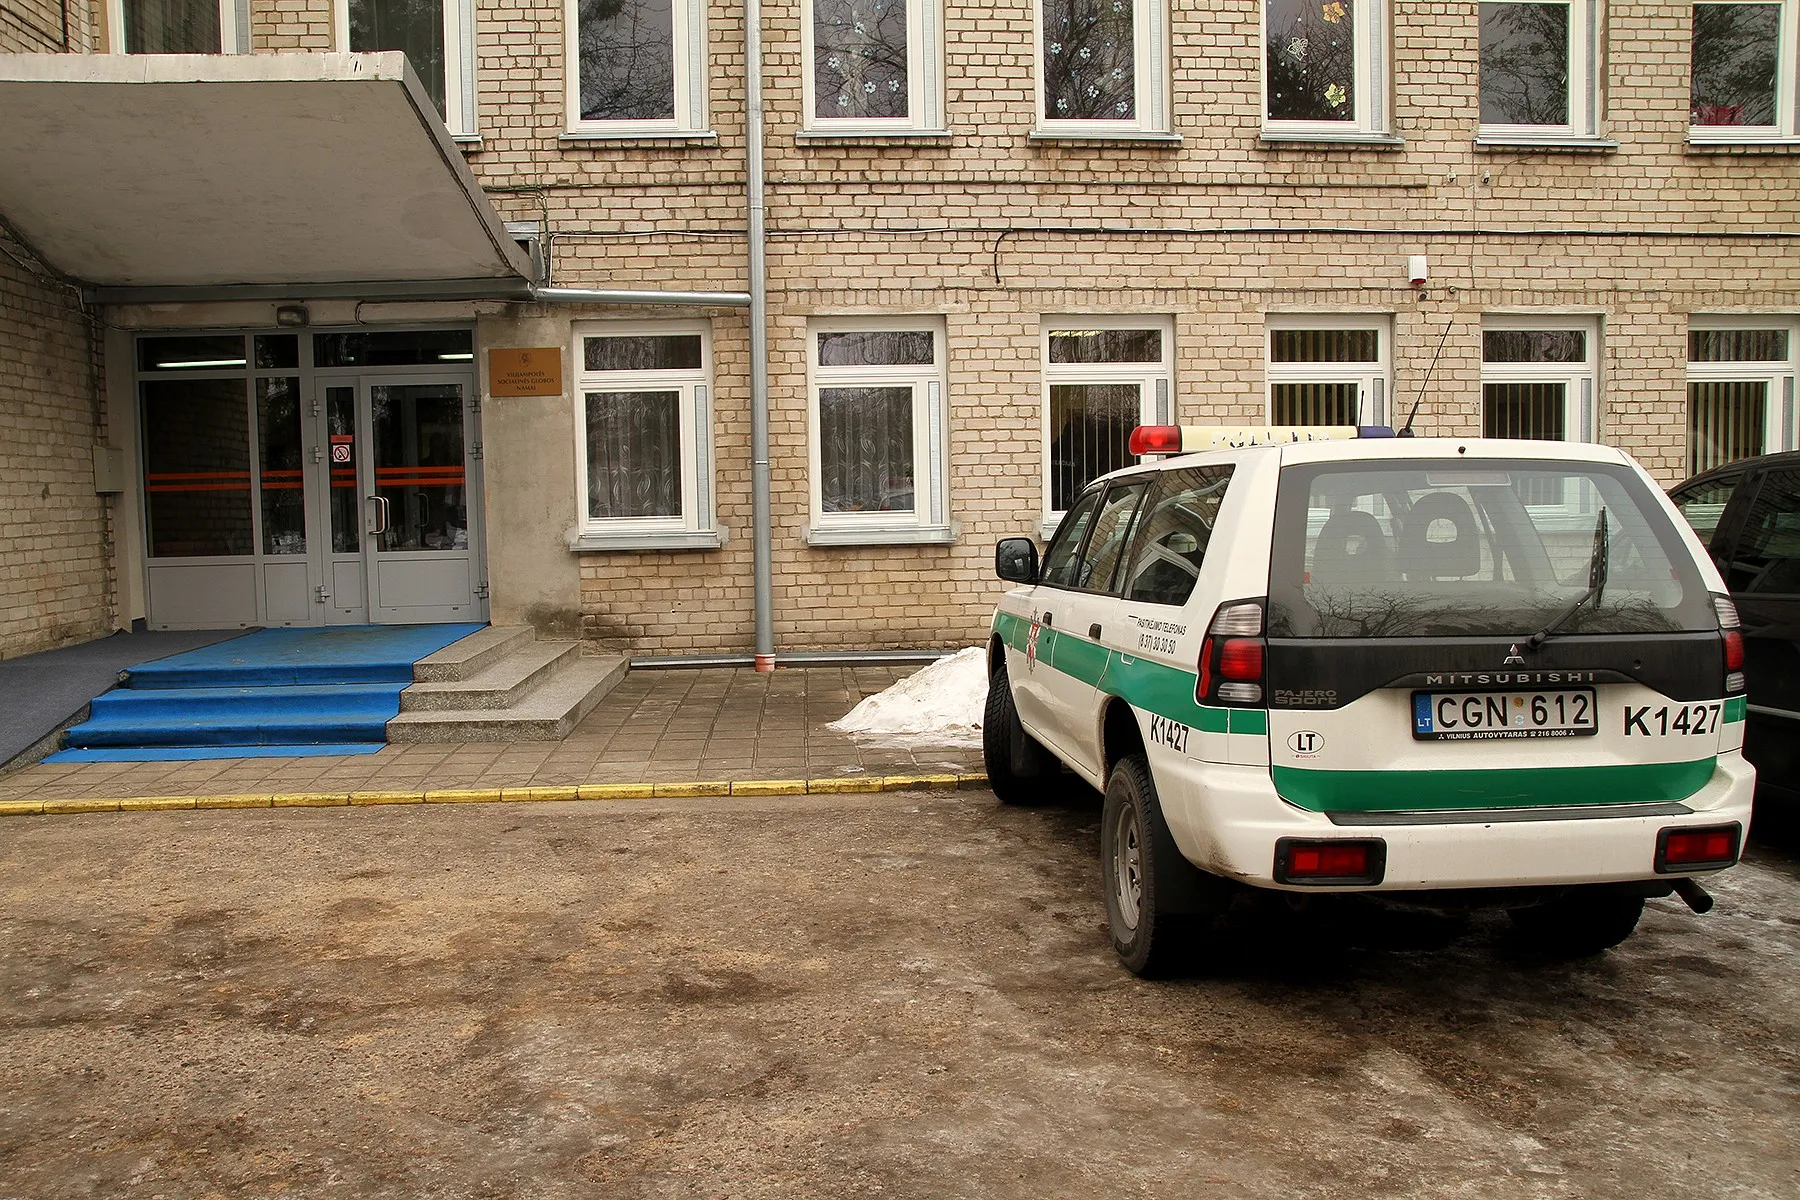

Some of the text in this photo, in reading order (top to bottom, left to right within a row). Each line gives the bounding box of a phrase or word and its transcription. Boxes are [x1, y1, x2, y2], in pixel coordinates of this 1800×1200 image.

[1426, 672, 1594, 685] MITSUBISHI
[1274, 689, 1337, 697] PAJERO
[1417, 694, 1590, 729] LT CGN 612
[1624, 703, 1721, 737] K1427
[1150, 713, 1190, 754] K1427
[1297, 733, 1316, 751] LT
[1446, 732, 1471, 740] VILNIUS
[1472, 730, 1528, 740] AUTOVYTARAS
